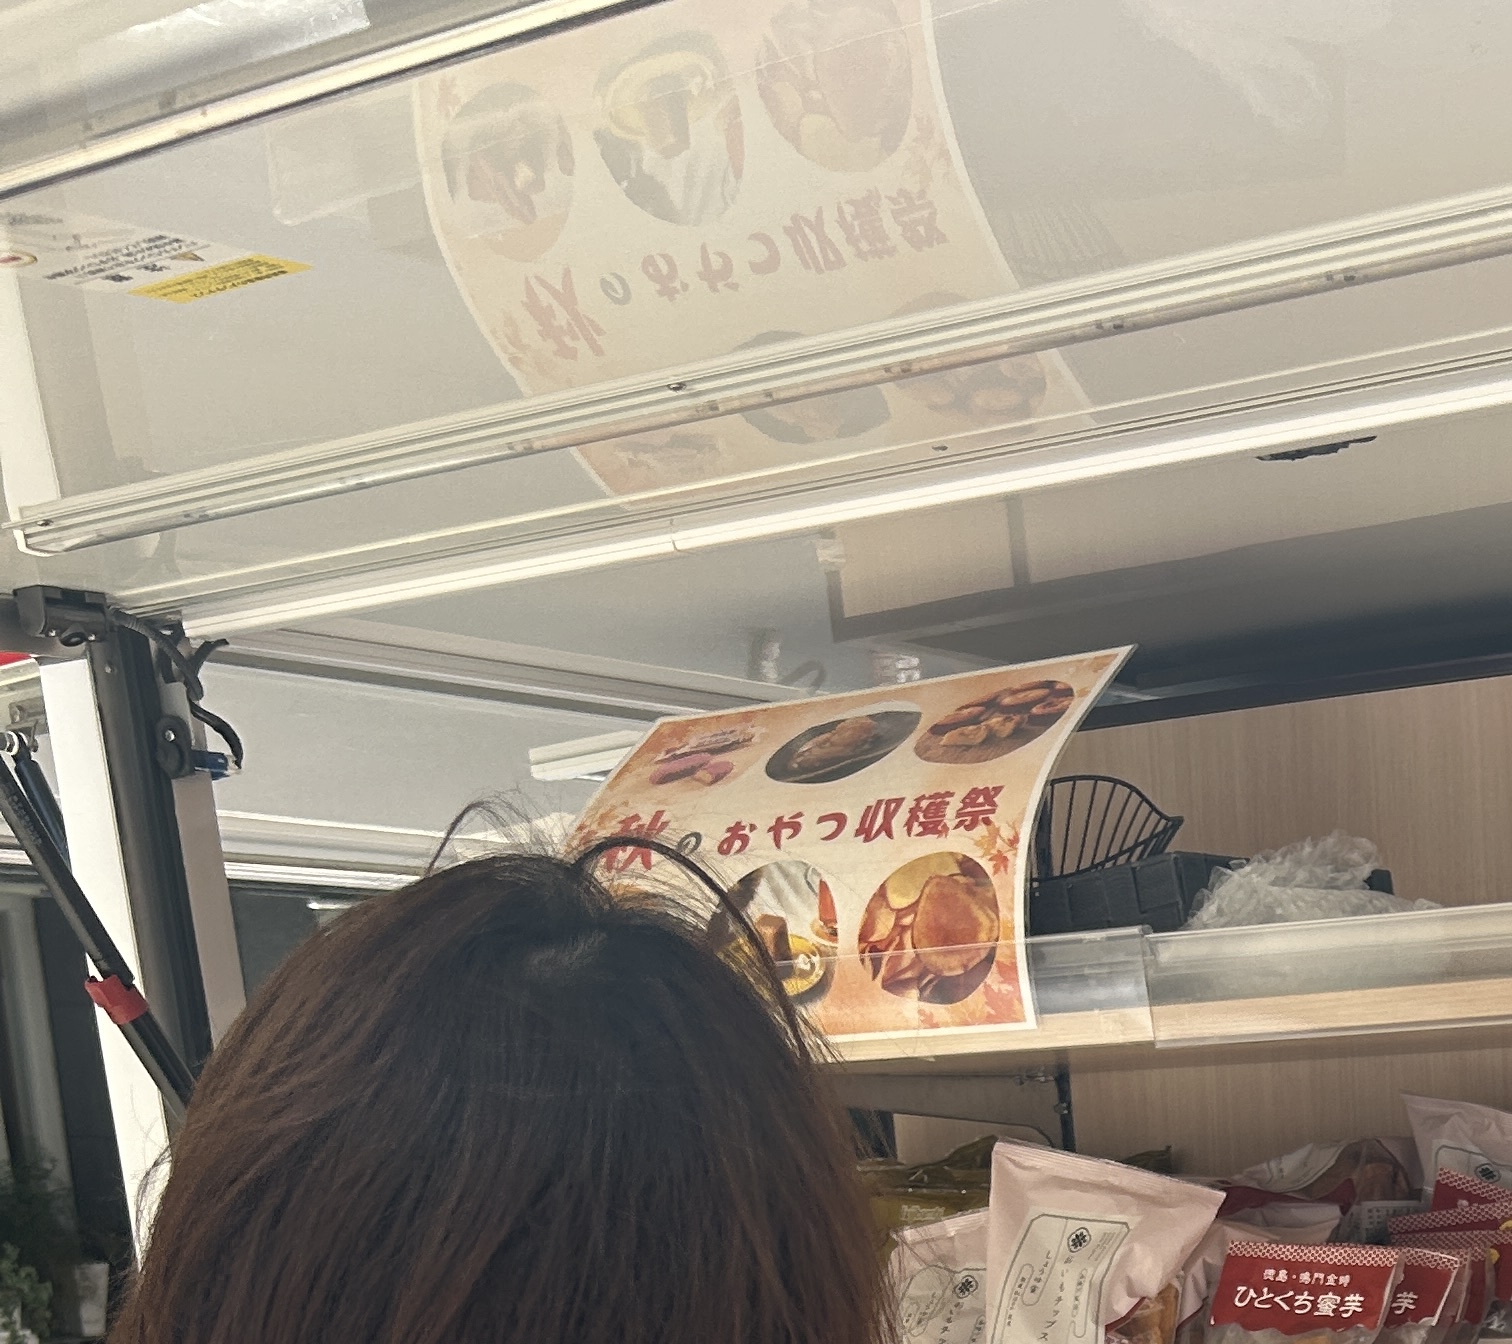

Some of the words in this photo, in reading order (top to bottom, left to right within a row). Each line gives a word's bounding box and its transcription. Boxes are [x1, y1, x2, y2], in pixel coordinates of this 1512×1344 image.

[600, 785, 1005, 873] 秋のおやつ収穫祭
[1233, 1284, 1365, 1319] ひとくち蜜芋
